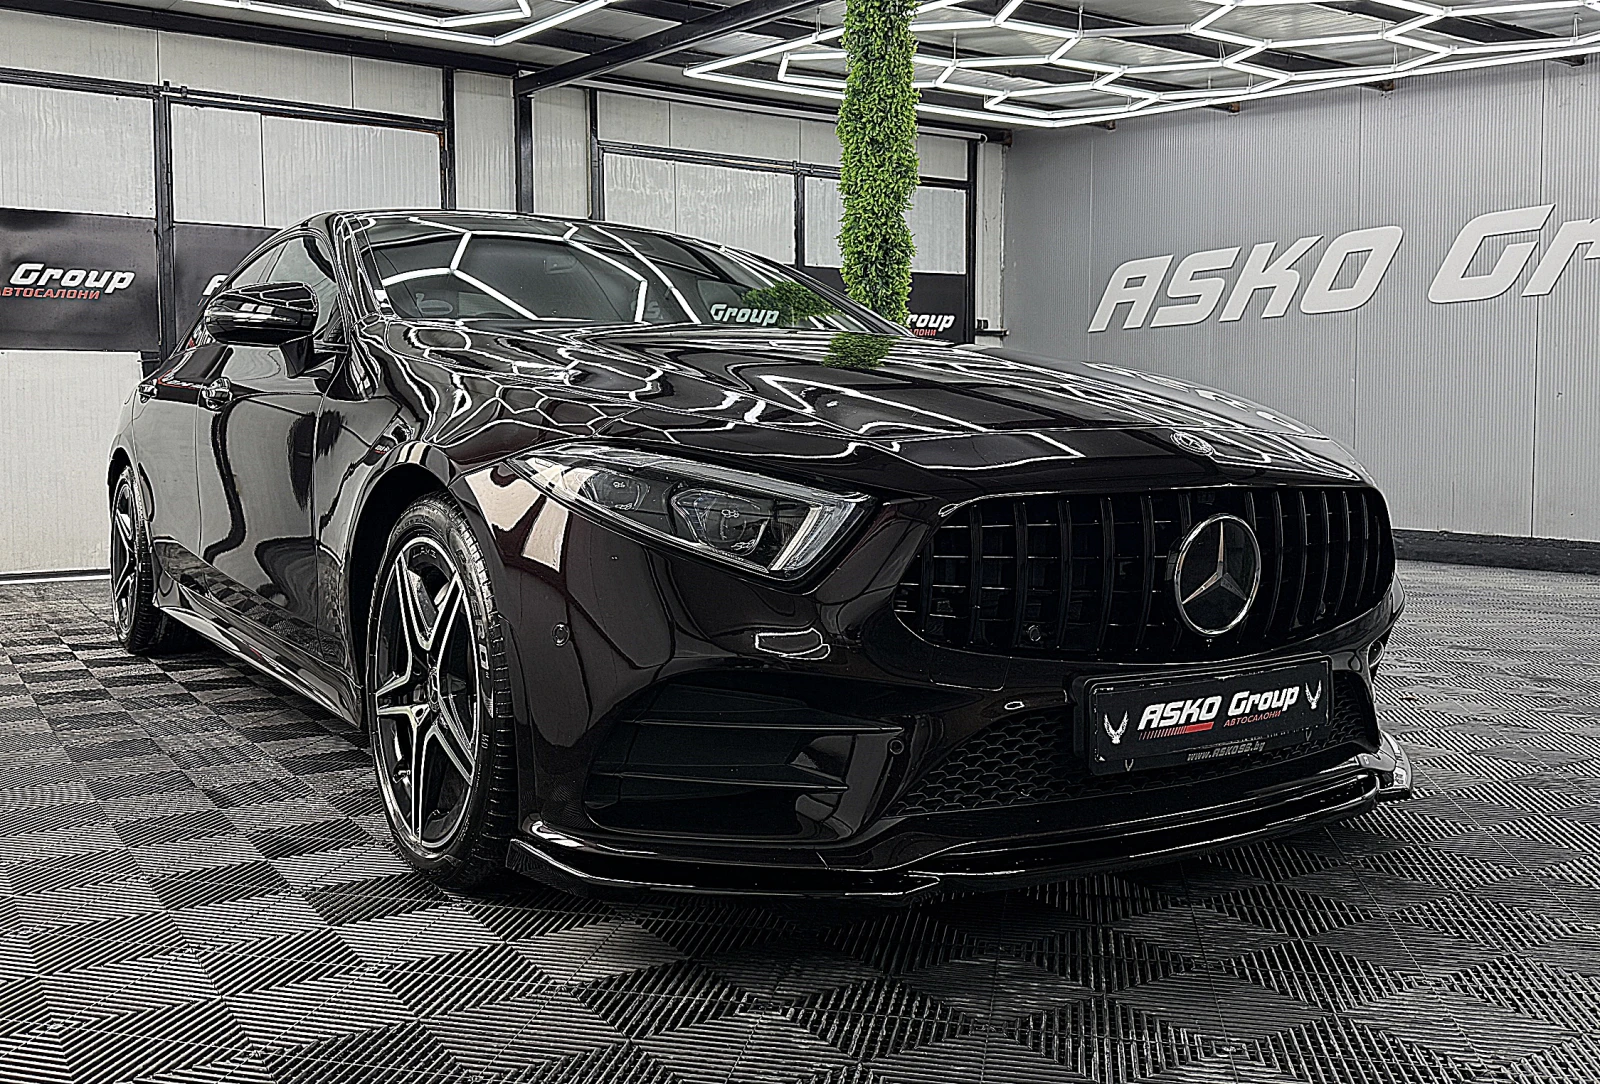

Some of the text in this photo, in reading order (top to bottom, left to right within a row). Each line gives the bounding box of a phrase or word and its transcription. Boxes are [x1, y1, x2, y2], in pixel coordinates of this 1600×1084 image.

[9, 263, 135, 294] Group
[1088, 226, 1403, 333] ASKO
[0, 286, 101, 300] ВТОСАЛОНИ
[710, 303, 779, 327] Group
[906, 314, 956, 332] roup
[1136, 685, 1300, 731] ASKO Group
[1223, 709, 1282, 728] АВТОСАЛОНИ
